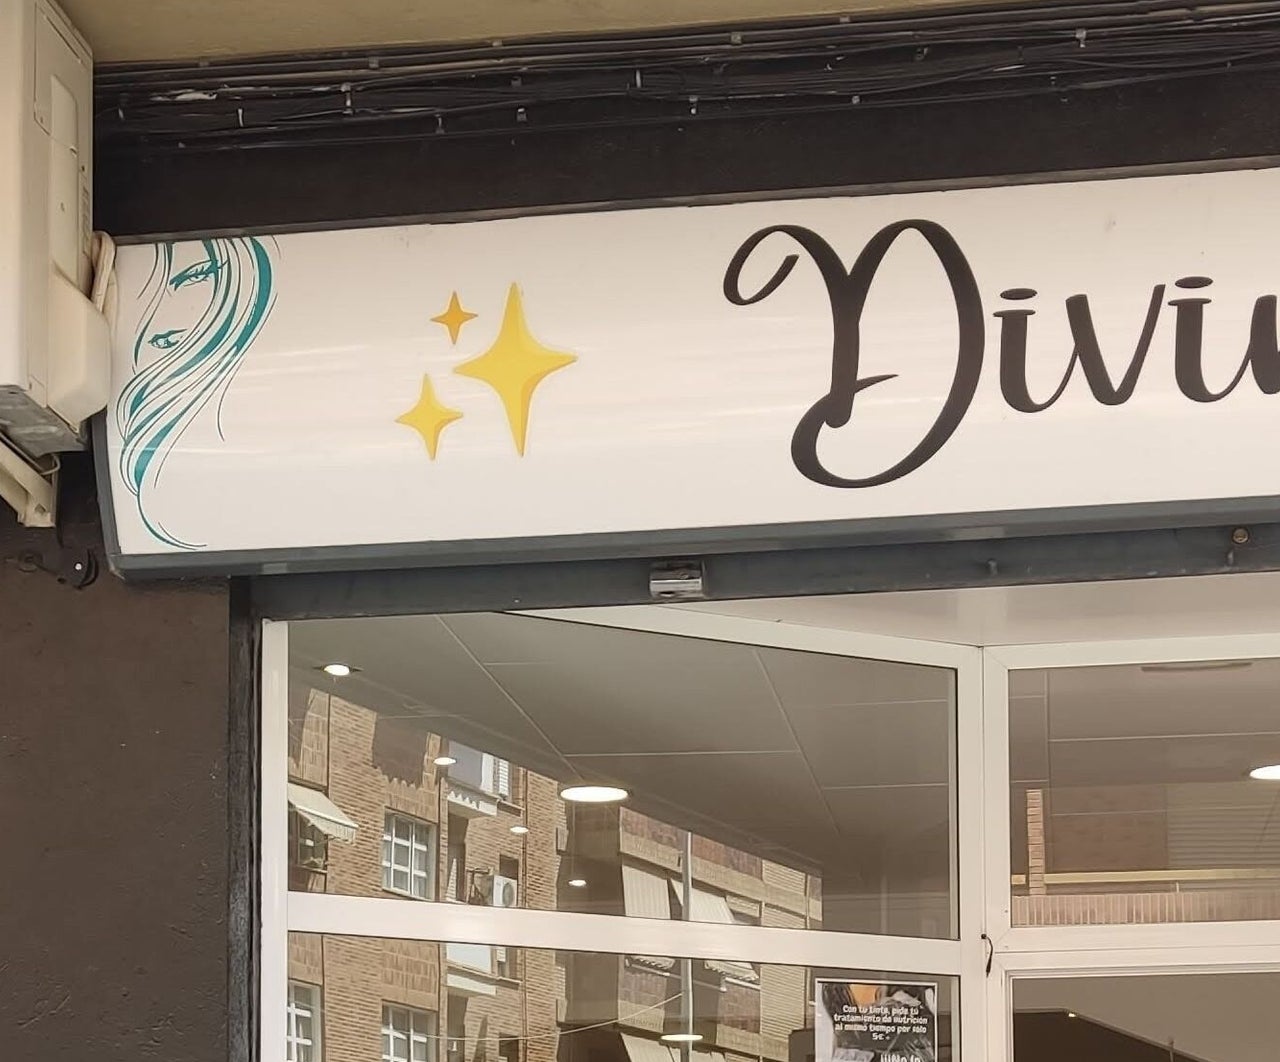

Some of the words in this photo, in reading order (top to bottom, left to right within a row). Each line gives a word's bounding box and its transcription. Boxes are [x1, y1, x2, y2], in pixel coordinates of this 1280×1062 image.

[834, 1013, 881, 1023] tratamiento
[882, 1015, 892, 1023] de
[893, 1015, 928, 1025] nutrición
[835, 1023, 843, 1031] al
[869, 1024, 895, 1034] tiempo
[897, 1026, 911, 1034] por
